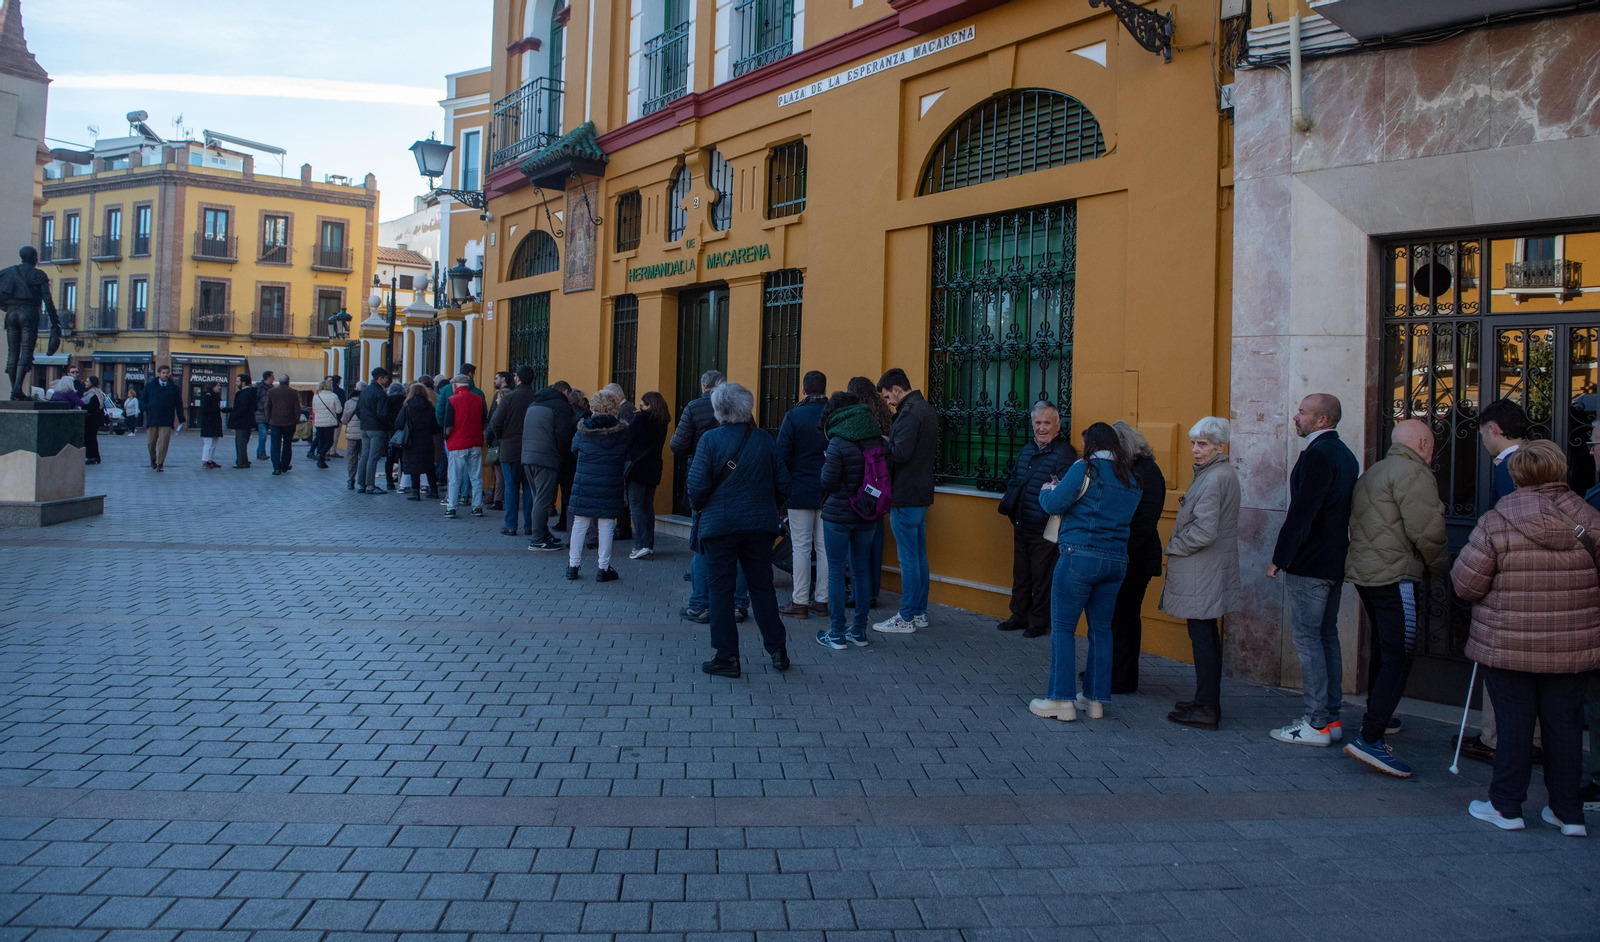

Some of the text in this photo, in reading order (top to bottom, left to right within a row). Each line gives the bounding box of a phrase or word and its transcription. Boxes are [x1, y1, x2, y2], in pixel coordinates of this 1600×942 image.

[778, 27, 974, 106] PLAZA DE LA ESPERANZA MACARENA
[693, 198, 699, 207] 2
[686, 238, 696, 249] DE
[684, 258, 696, 272] LA
[706, 243, 771, 269] MACARENA
[190, 374, 228, 383] MACARENA
